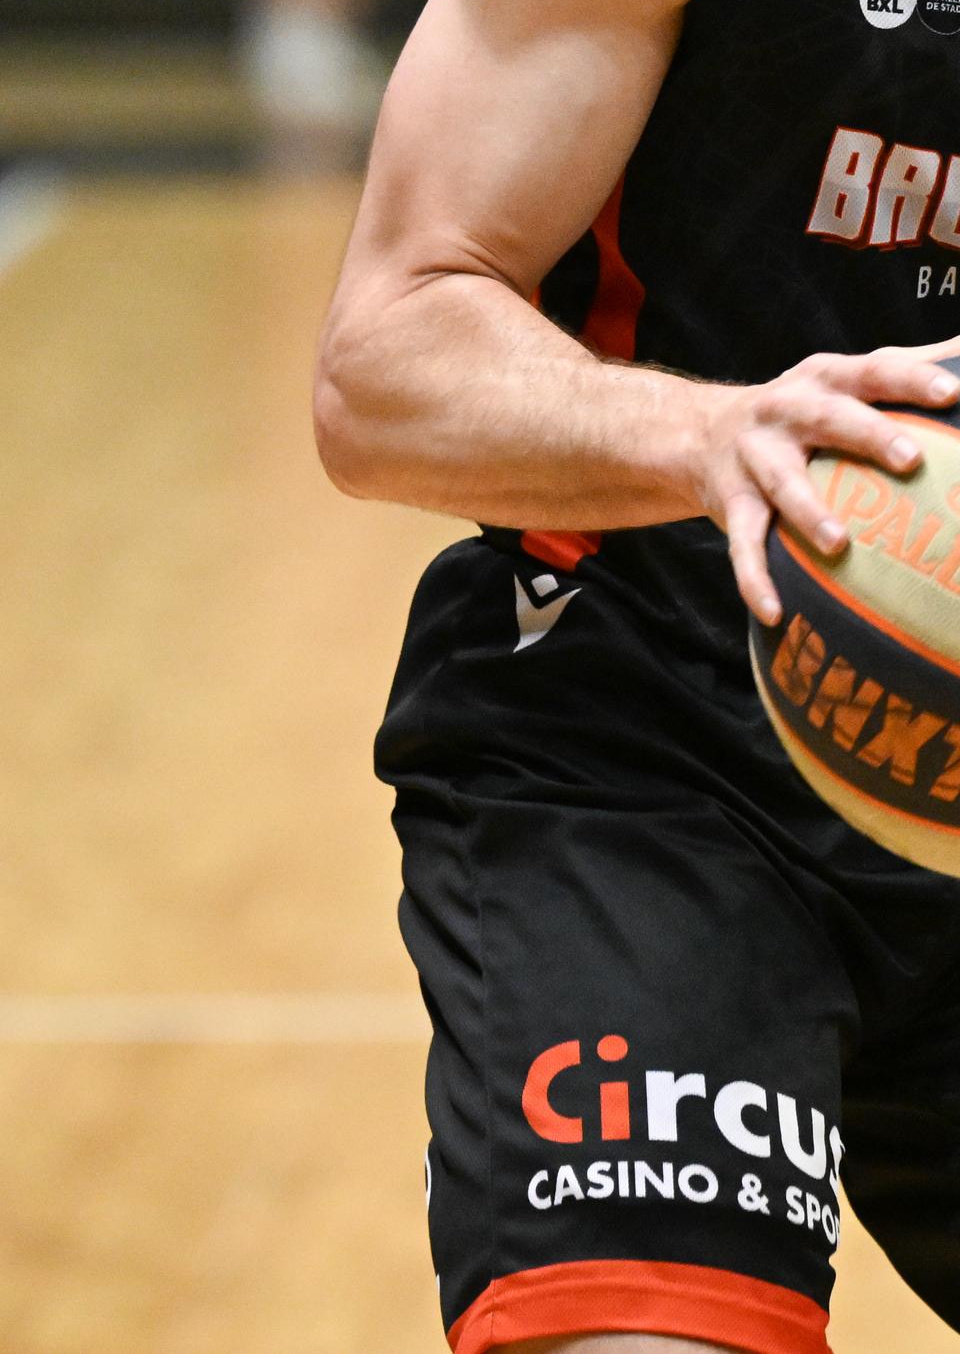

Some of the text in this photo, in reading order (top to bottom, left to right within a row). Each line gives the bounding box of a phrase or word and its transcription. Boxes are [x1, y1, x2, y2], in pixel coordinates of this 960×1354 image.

[926, 2, 939, 11] DE
[527, 1160, 720, 1211] CASINO
[737, 1173, 771, 1215] &
